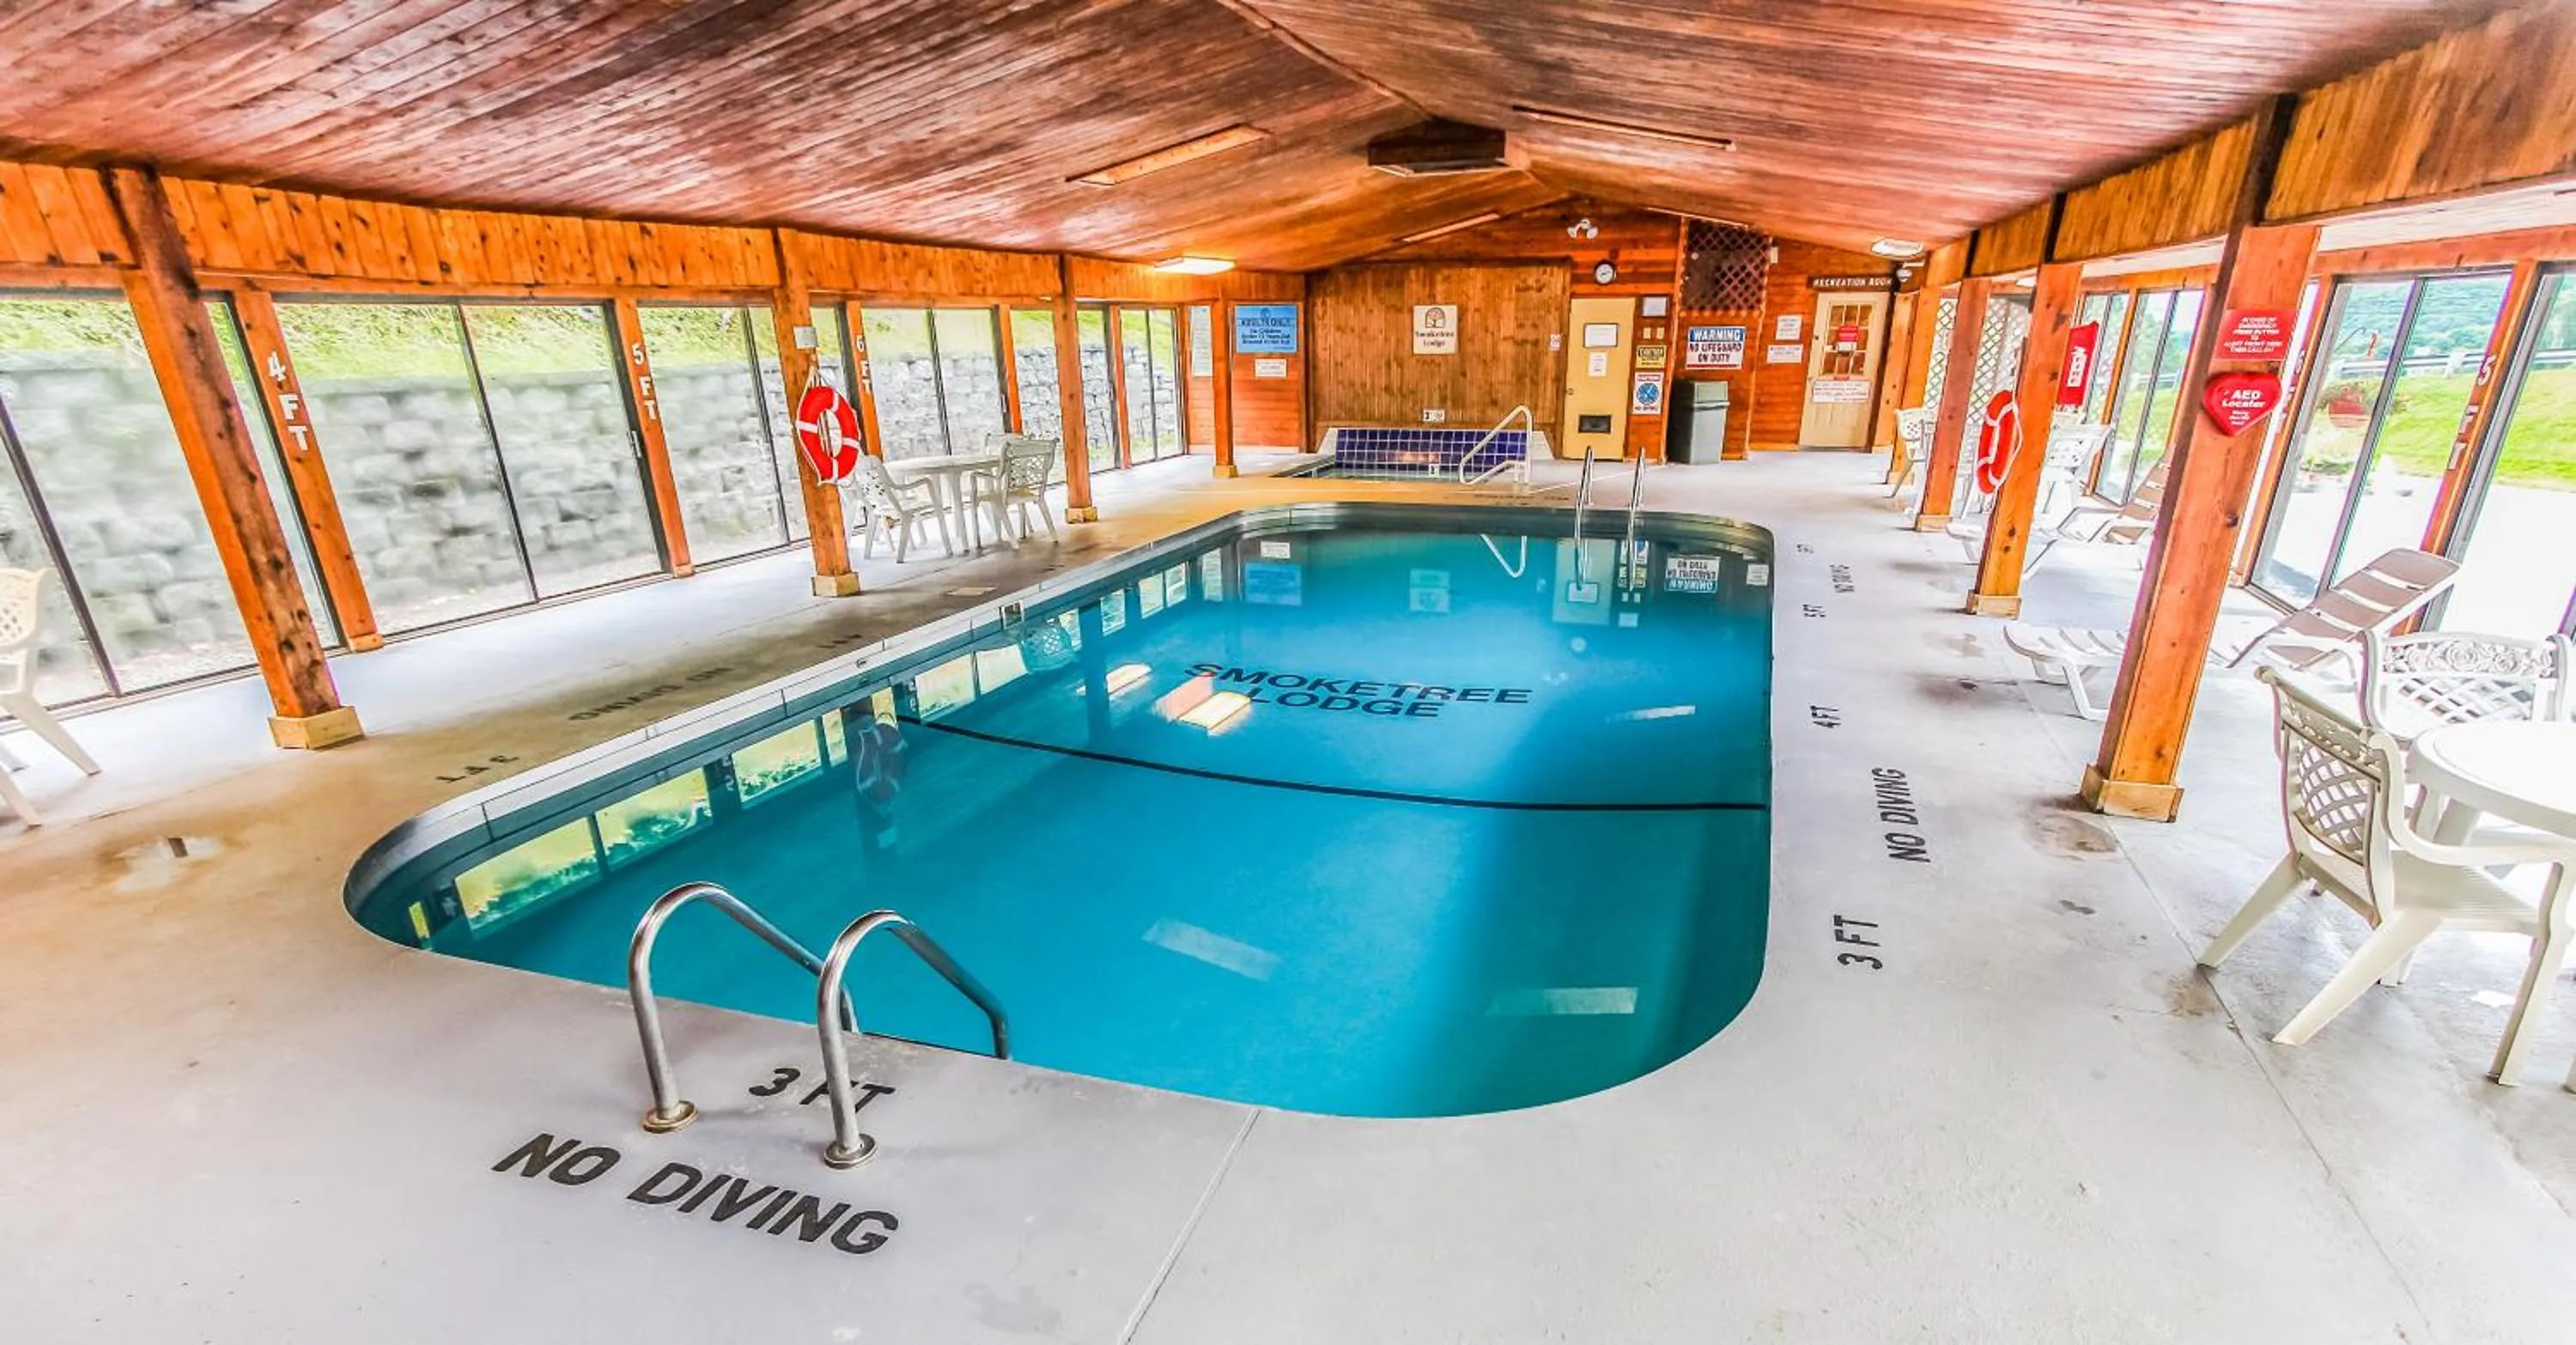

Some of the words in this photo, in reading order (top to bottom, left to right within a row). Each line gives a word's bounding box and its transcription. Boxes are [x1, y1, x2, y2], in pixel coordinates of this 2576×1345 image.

[1813, 277, 1866, 288] RECREATION
[1868, 277, 1892, 286] ROOM
[856, 335, 865, 352] 6
[1694, 329, 1741, 341] WARNING
[1690, 343, 1699, 352] NO
[1702, 343, 1741, 353] LIFEGUARD
[1698, 353, 1709, 362] ON
[1710, 353, 1730, 362] DUTY
[632, 344, 644, 365] 5
[639, 376, 657, 419] FT
[267, 351, 286, 382] 4
[279, 394, 309, 451] FT
[2221, 399, 2267, 408] Locator
[2231, 389, 2262, 399] AED
[1184, 663, 1534, 704] SMOKETREE
[1249, 688, 1448, 717] LODGE
[1810, 705, 1841, 720] FT
[1813, 721, 1841, 729] 4
[1871, 768, 1919, 825] DIVING
[1885, 832, 1930, 862] NO
[1833, 915, 1881, 946] FT
[1838, 952, 1883, 971] 3
[749, 1068, 800, 1096] 3
[491, 1133, 620, 1186] NO
[627, 1162, 899, 1255] DIVING
